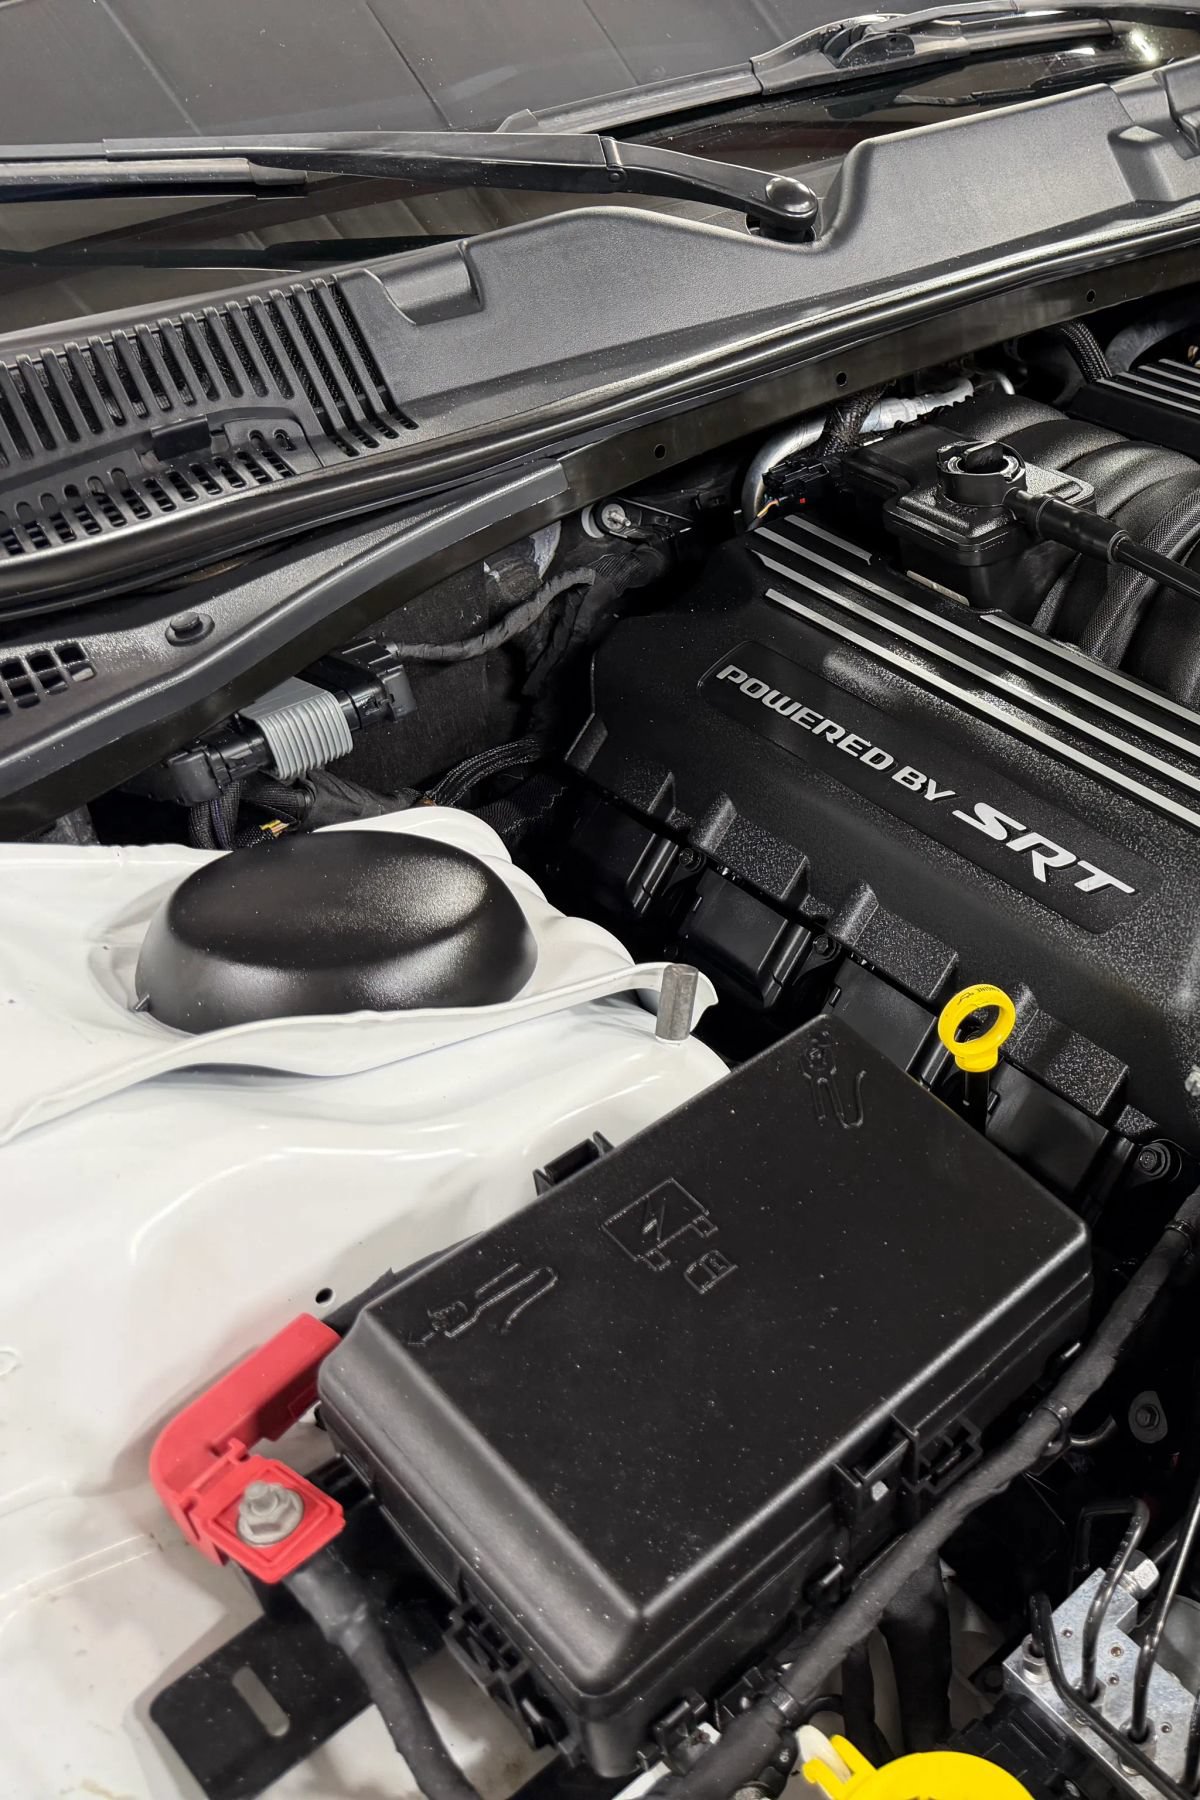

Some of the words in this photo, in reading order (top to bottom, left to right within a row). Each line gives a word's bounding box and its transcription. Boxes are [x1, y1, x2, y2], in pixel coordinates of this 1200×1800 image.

[716, 664, 895, 771] POWERED
[891, 765, 956, 801] BY
[951, 801, 1136, 895] SRT
